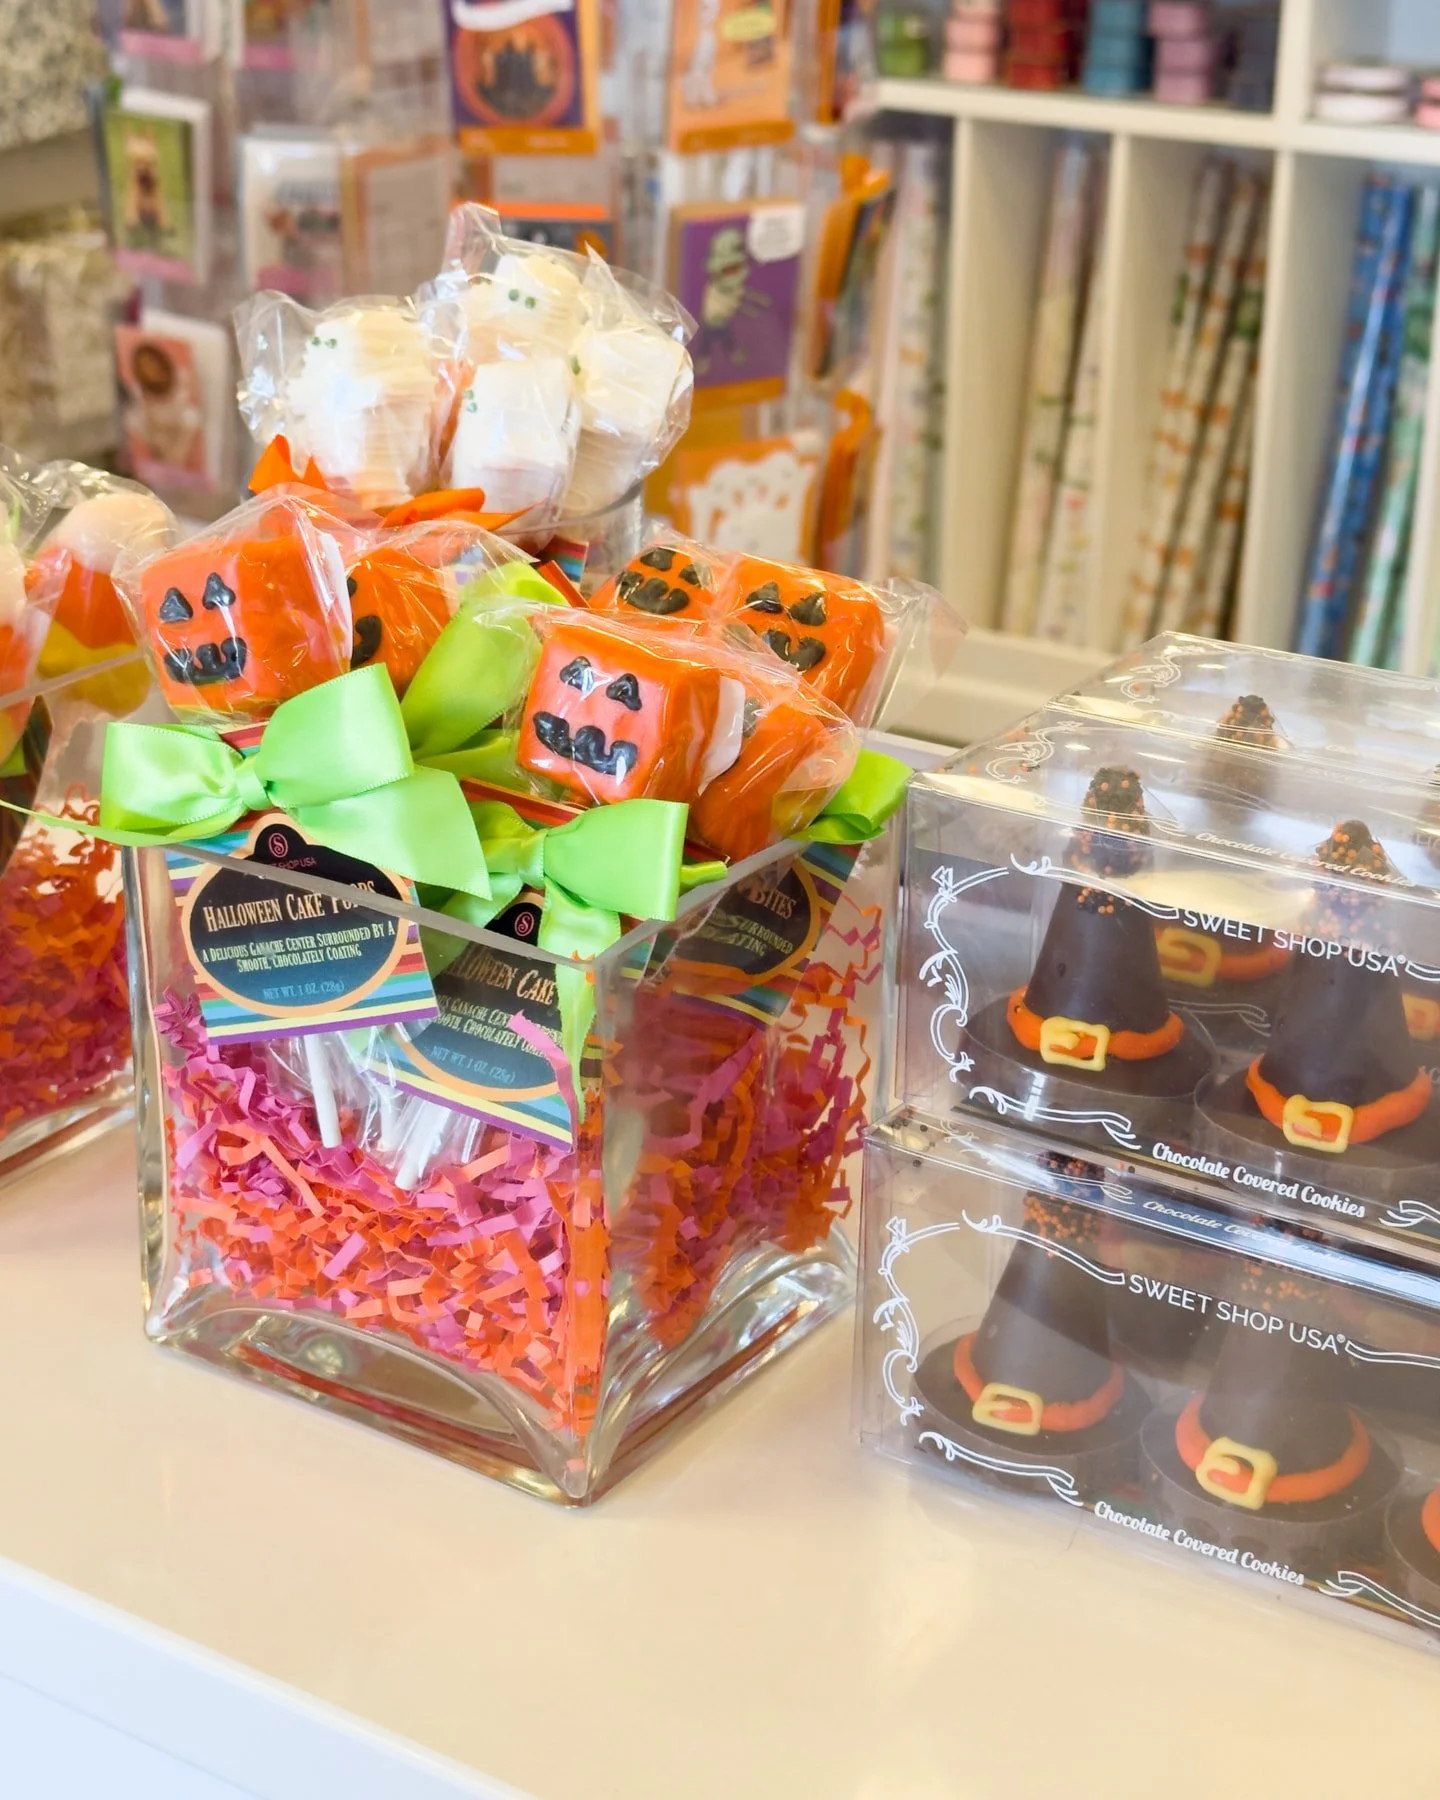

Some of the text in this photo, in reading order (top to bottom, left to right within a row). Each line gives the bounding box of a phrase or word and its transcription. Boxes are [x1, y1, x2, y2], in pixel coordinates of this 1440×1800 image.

[300, 857, 317, 868] USA
[203, 898, 283, 932] HALLOWEEN
[286, 893, 326, 921] CAKE
[203, 921, 396, 963] A DELICIOUS GANACHE CENTER SURROUNDED BY A
[1183, 909, 1269, 943] SWEET
[1273, 930, 1342, 960] SHOP
[236, 943, 362, 974] SMOOTH, CHOCOLATELY COATING
[262, 986, 279, 1000] NET
[516, 969, 556, 1006] CAKE
[463, 1018, 521, 1049] CHOCOLATELY
[430, 1045, 449, 1060] NET
[1152, 1142, 1366, 1218] Chocolate Covered Cookies
[1143, 1201, 1223, 1229] Chocolate
[1129, 1274, 1212, 1314] SWEET
[1216, 1301, 1284, 1334] SHOP
[1094, 1501, 1305, 1586] Chocolate Covered Cookies
